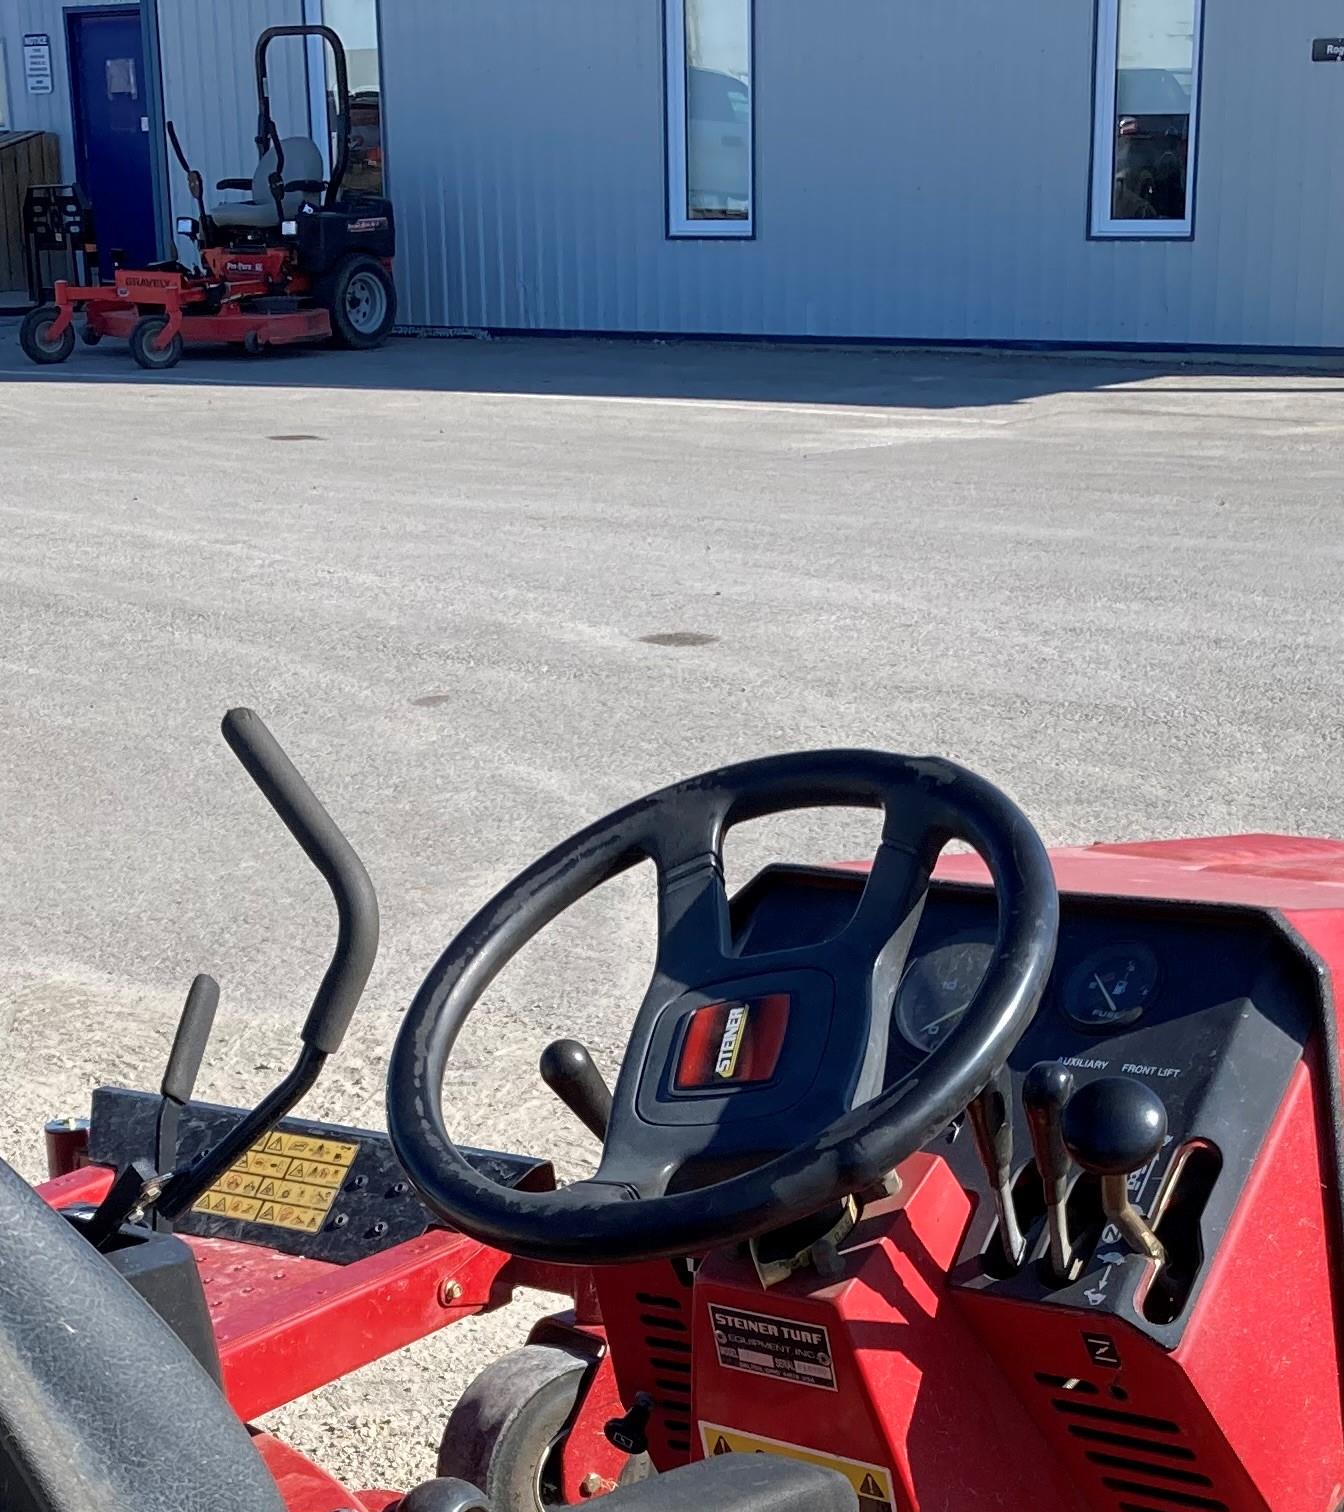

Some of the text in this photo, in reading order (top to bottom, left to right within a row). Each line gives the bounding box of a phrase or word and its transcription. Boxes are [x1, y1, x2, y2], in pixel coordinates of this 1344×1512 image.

[125, 277, 171, 288] GRAVELY
[715, 1006, 745, 1074] STEINER
[1056, 1055, 1182, 1079] AUXILIARY FRONT LIFT
[715, 1313, 823, 1346] STEINER TURF
